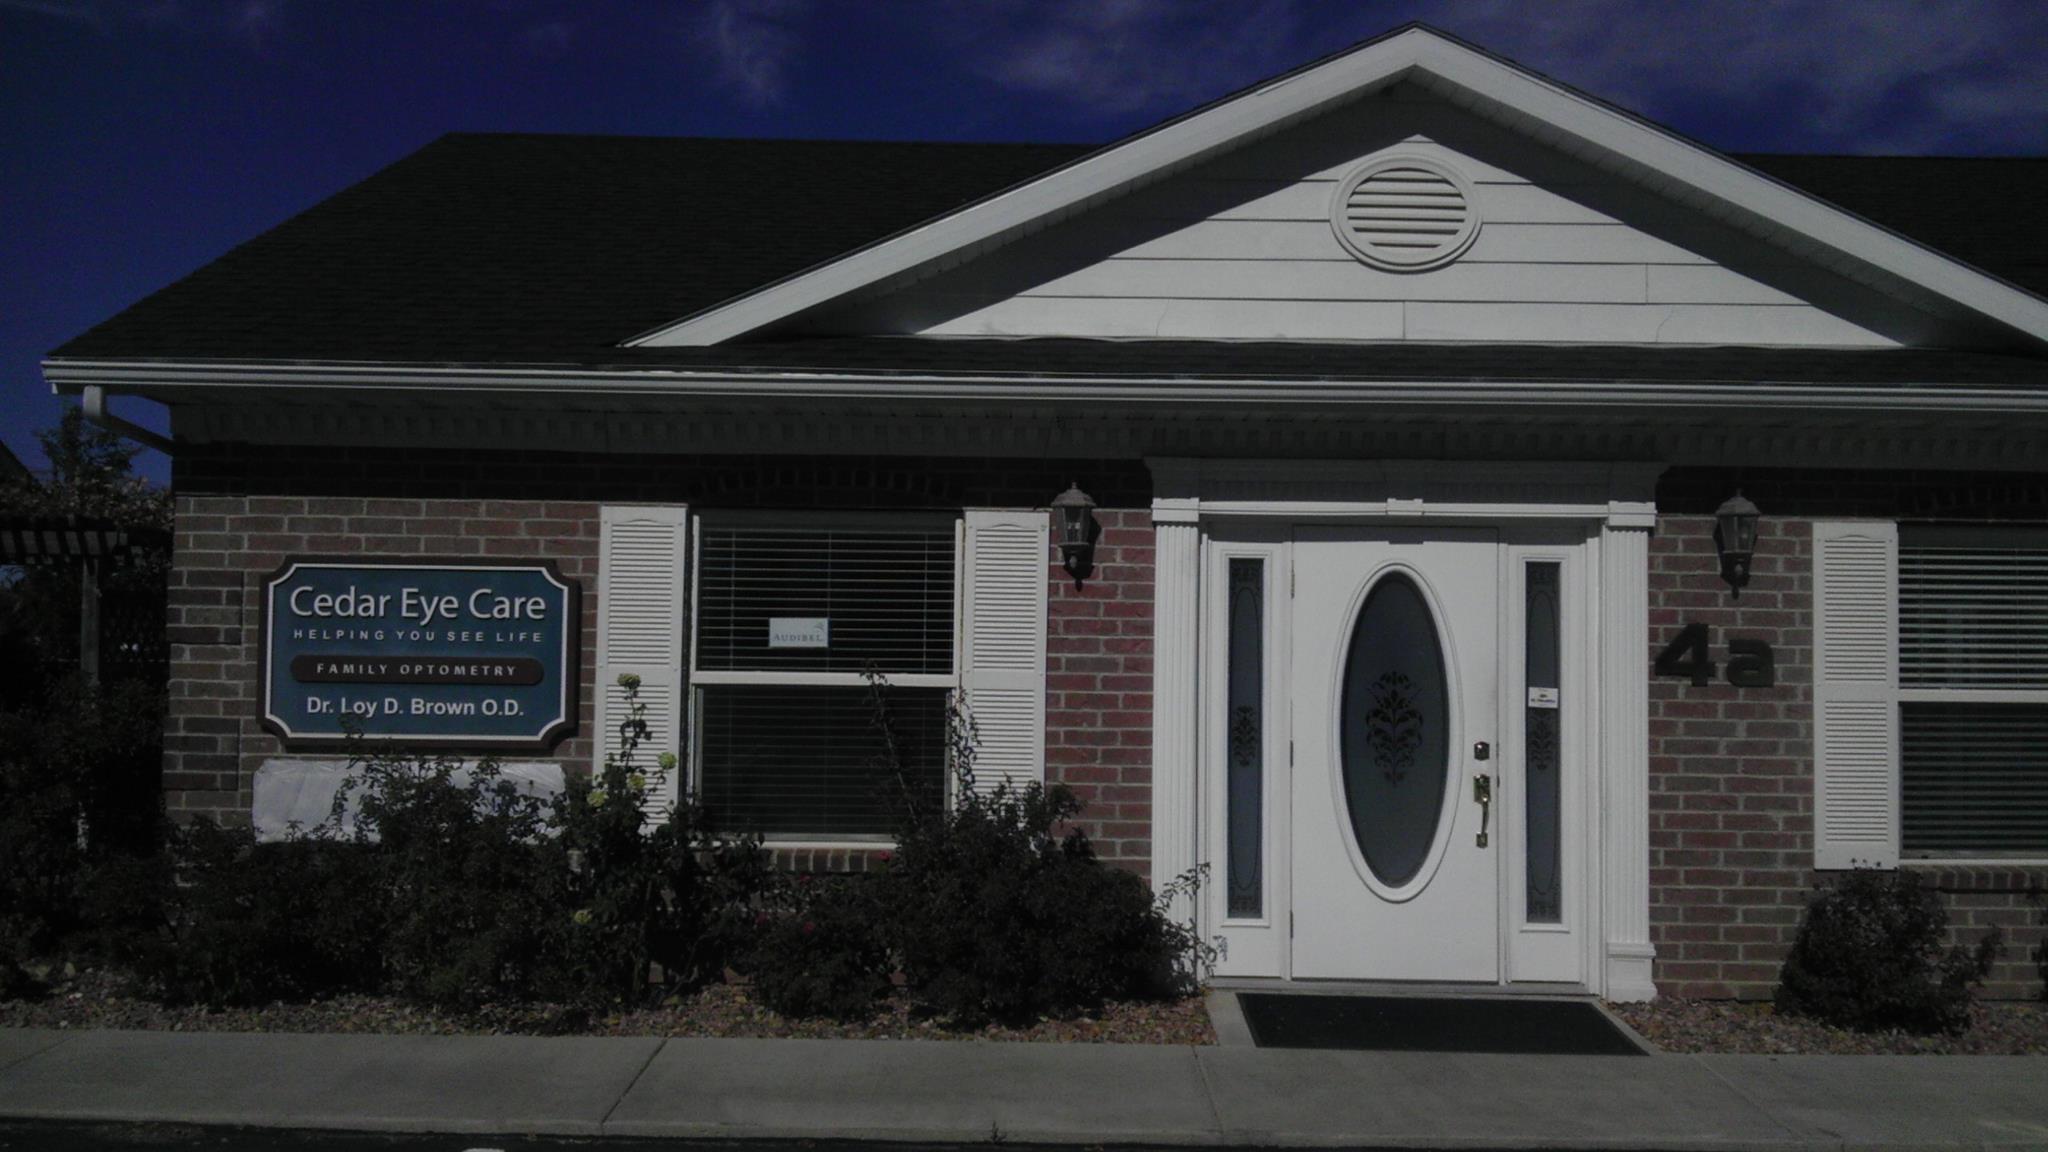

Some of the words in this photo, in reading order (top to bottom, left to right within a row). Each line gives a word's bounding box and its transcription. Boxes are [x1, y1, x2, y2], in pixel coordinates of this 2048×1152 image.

[290, 585, 390, 618] Cedar
[401, 587, 459, 626] Eye
[468, 588, 546, 620] Care
[294, 629, 385, 641] HELPING
[397, 631, 435, 642] YOU
[447, 631, 485, 642] SEE
[496, 632, 543, 643] LIFE
[316, 663, 388, 675] FAMILY
[400, 664, 517, 676] OPTOMETRY
[307, 697, 334, 714] Dr.
[341, 698, 377, 718] Loy
[384, 699, 404, 715] D.
[411, 699, 475, 716] Brown
[482, 700, 524, 717] O.D.
